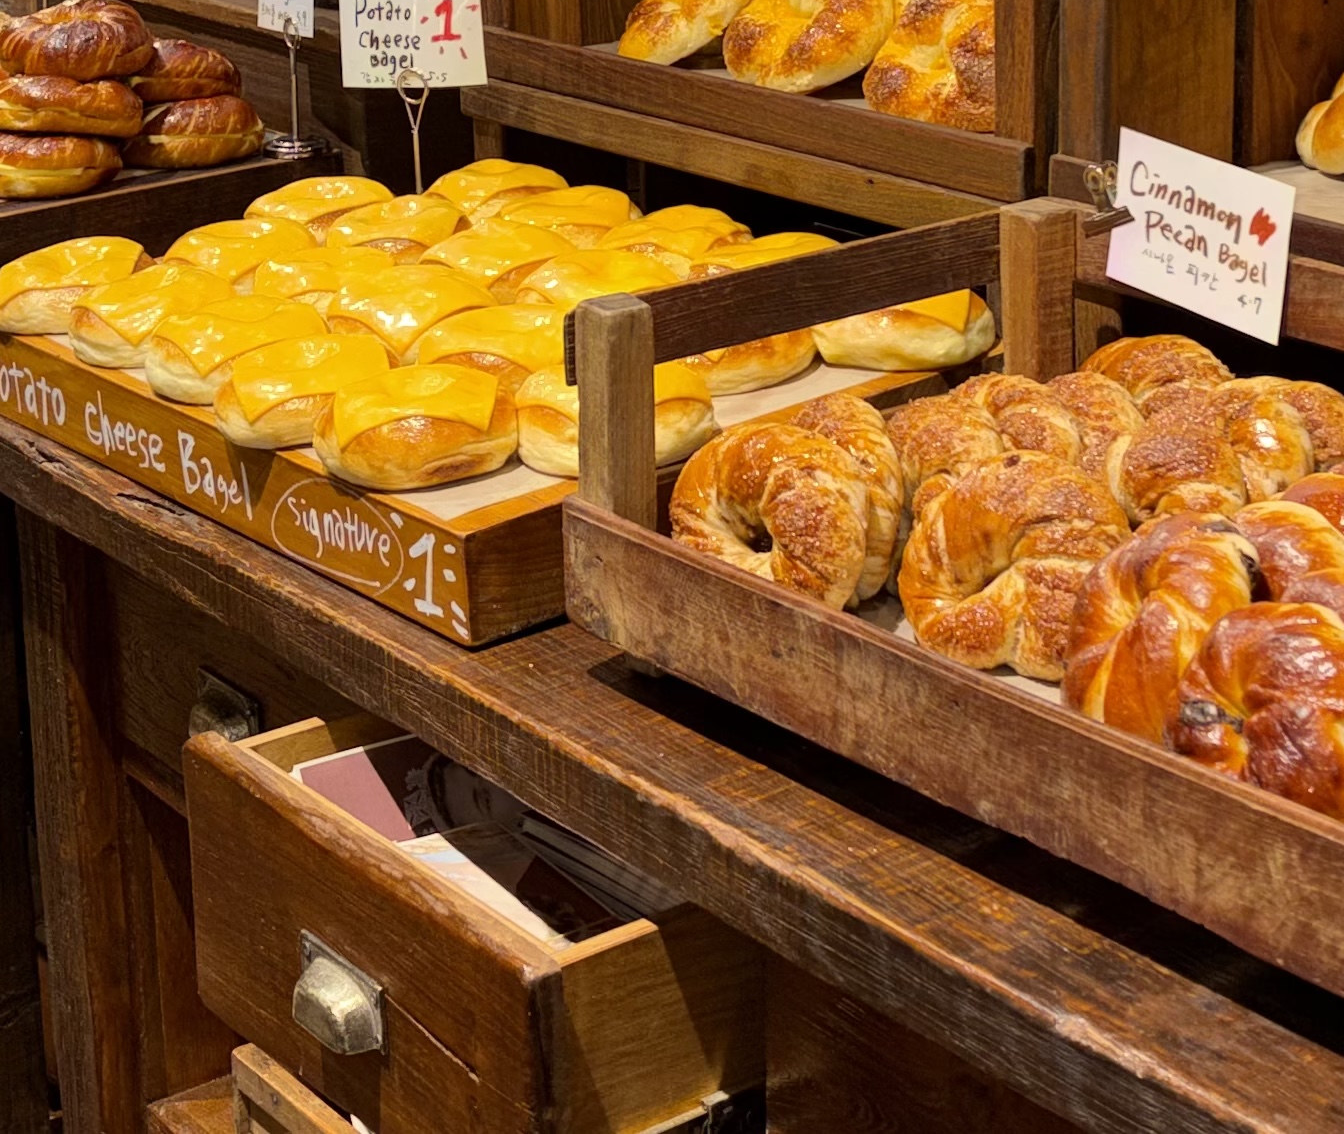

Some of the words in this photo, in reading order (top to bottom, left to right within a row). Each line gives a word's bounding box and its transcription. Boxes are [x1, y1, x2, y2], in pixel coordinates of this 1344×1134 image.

[359, 29, 421, 51] Cheese
[1130, 160, 1242, 244] Cinnamon
[1145, 210, 1209, 258] Pecan
[1218, 242, 1268, 288] Bagel
[1237, 293, 1262, 315] 4.7
[84, 390, 167, 474] Cheese
[177, 428, 254, 522] Bagel
